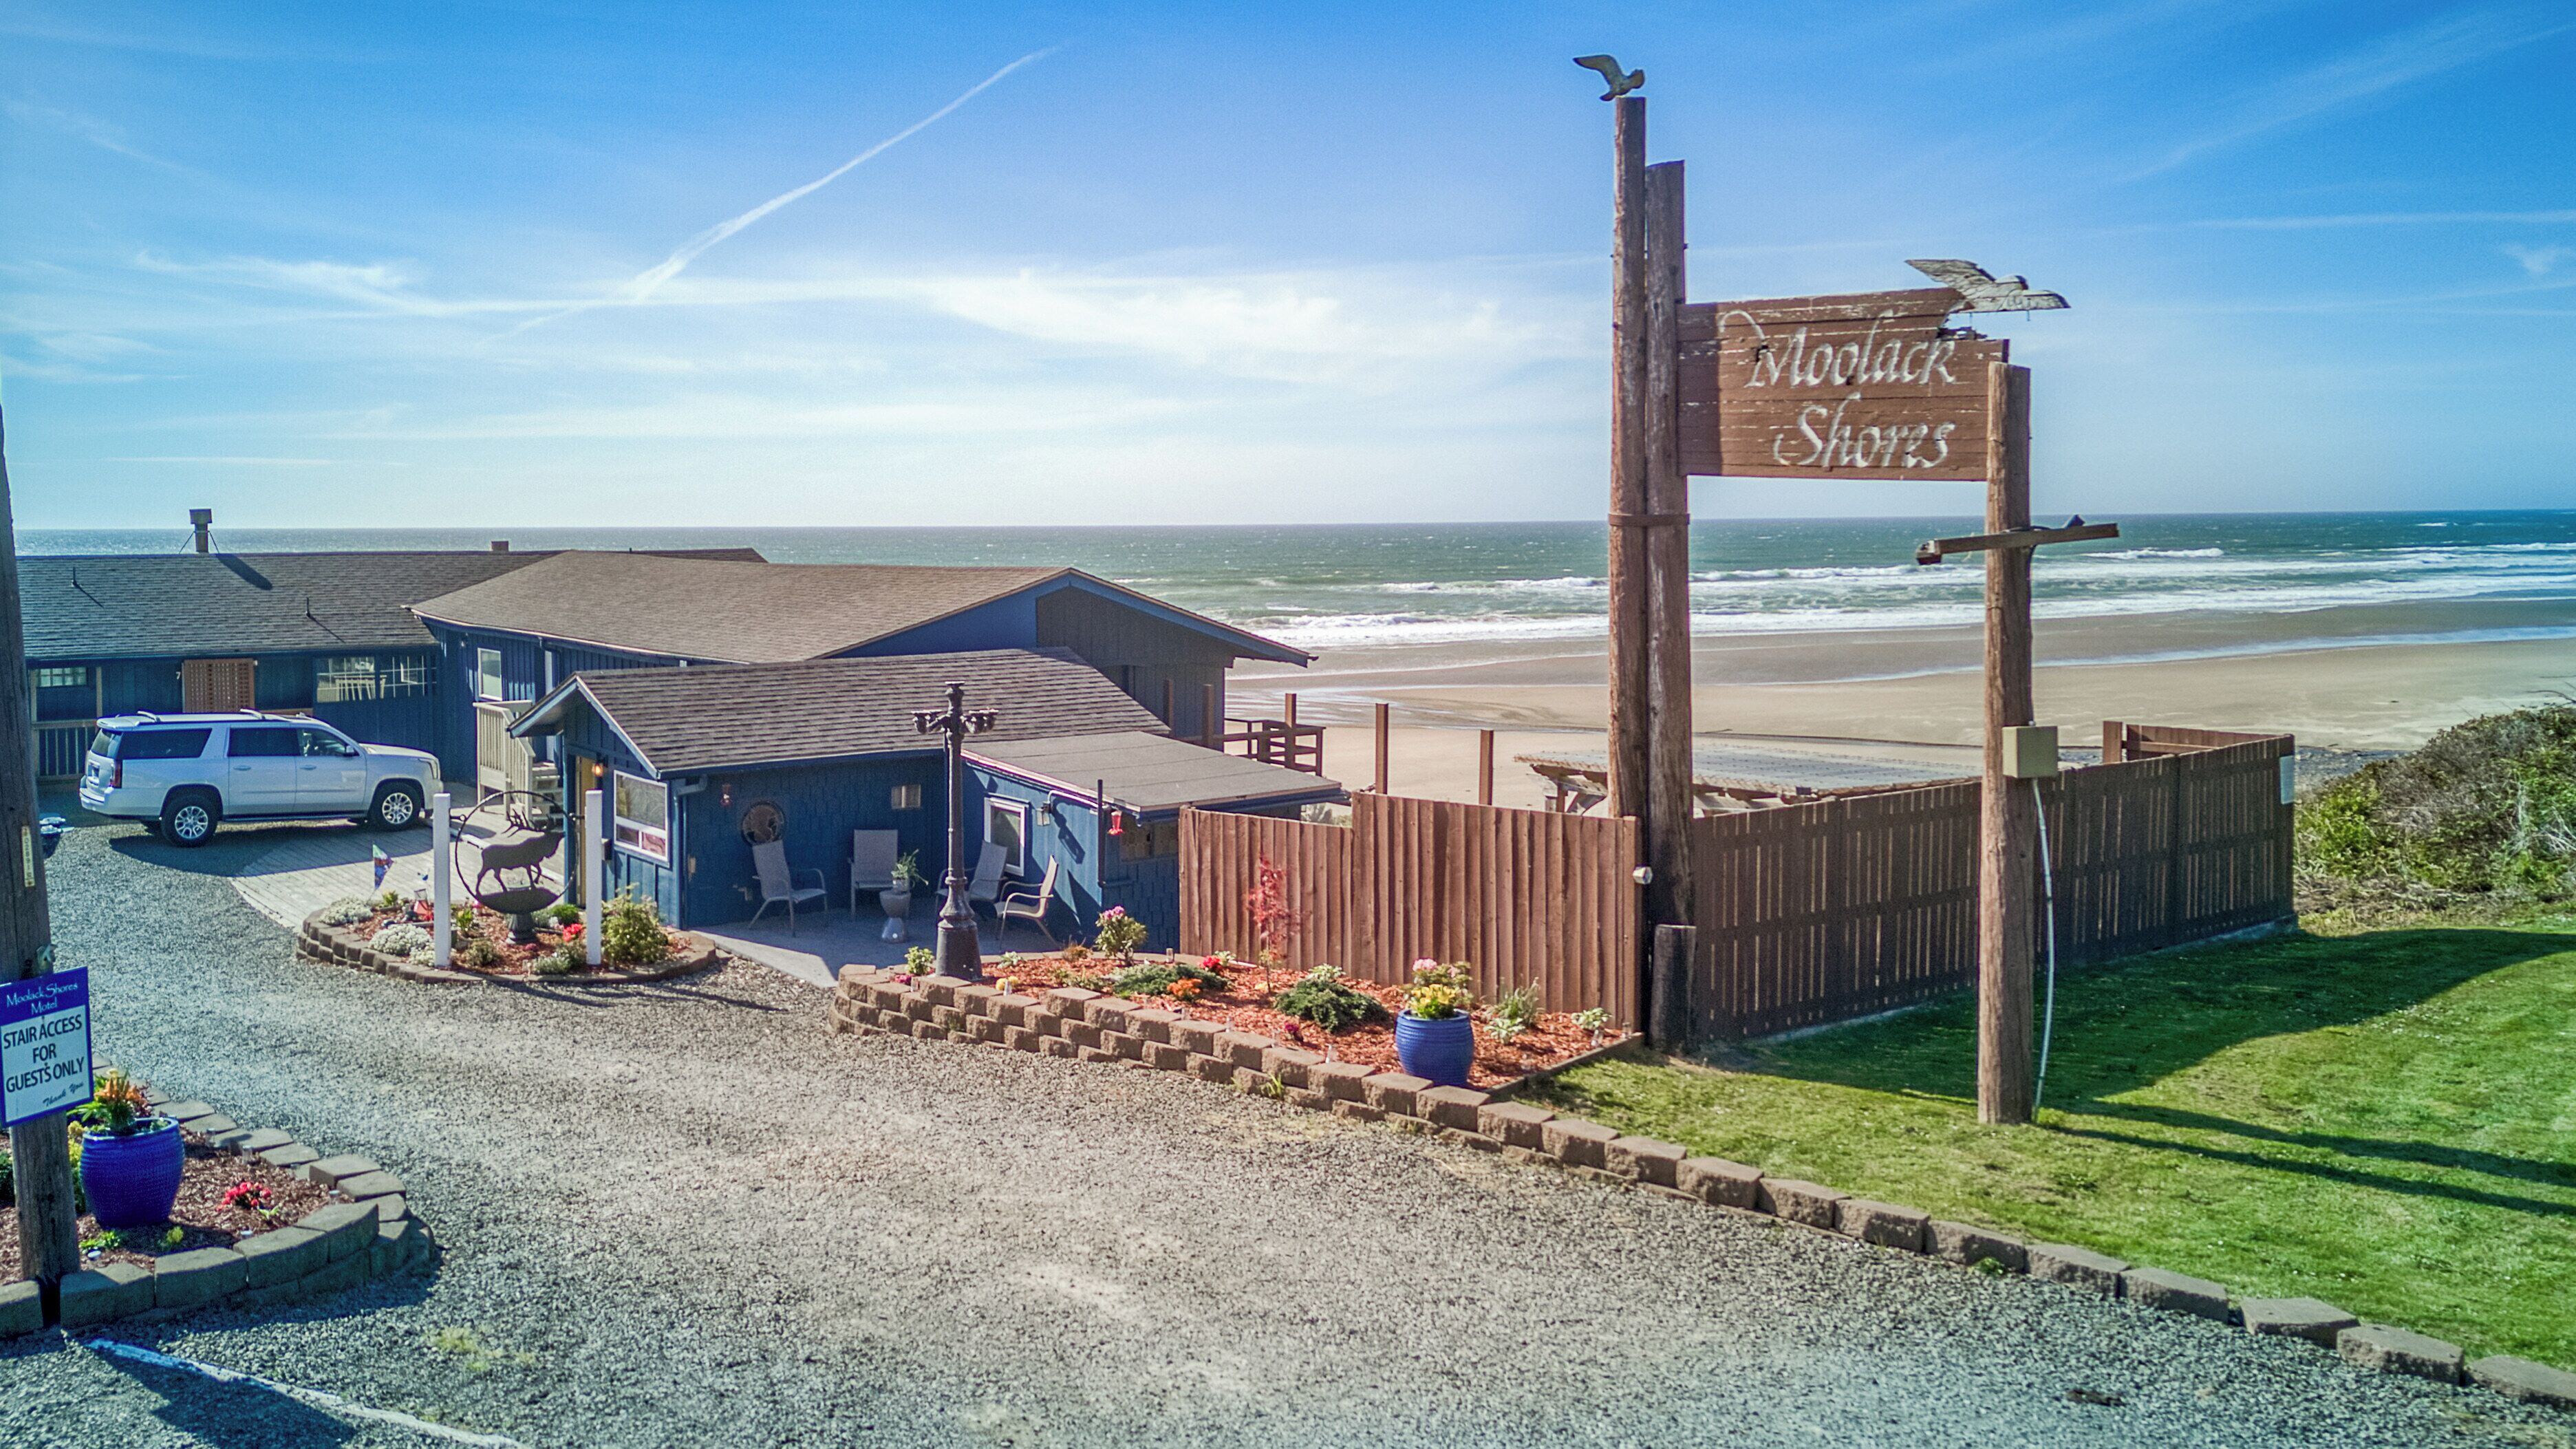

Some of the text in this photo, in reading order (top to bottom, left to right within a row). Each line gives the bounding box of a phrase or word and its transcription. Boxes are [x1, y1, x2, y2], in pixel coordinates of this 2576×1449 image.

[1719, 308, 1957, 388] Moolack
[1772, 391, 1956, 469] Shores
[175, 672, 182, 680] 7
[6, 983, 78, 1008] Moolack Shores
[31, 996, 58, 1015] Motel
[3, 1014, 82, 1049] STAIR ACCESS
[32, 1043, 57, 1064] FOR
[6, 1056, 84, 1093] GUESTS ONLY
[43, 1082, 84, 1106] Thank You
